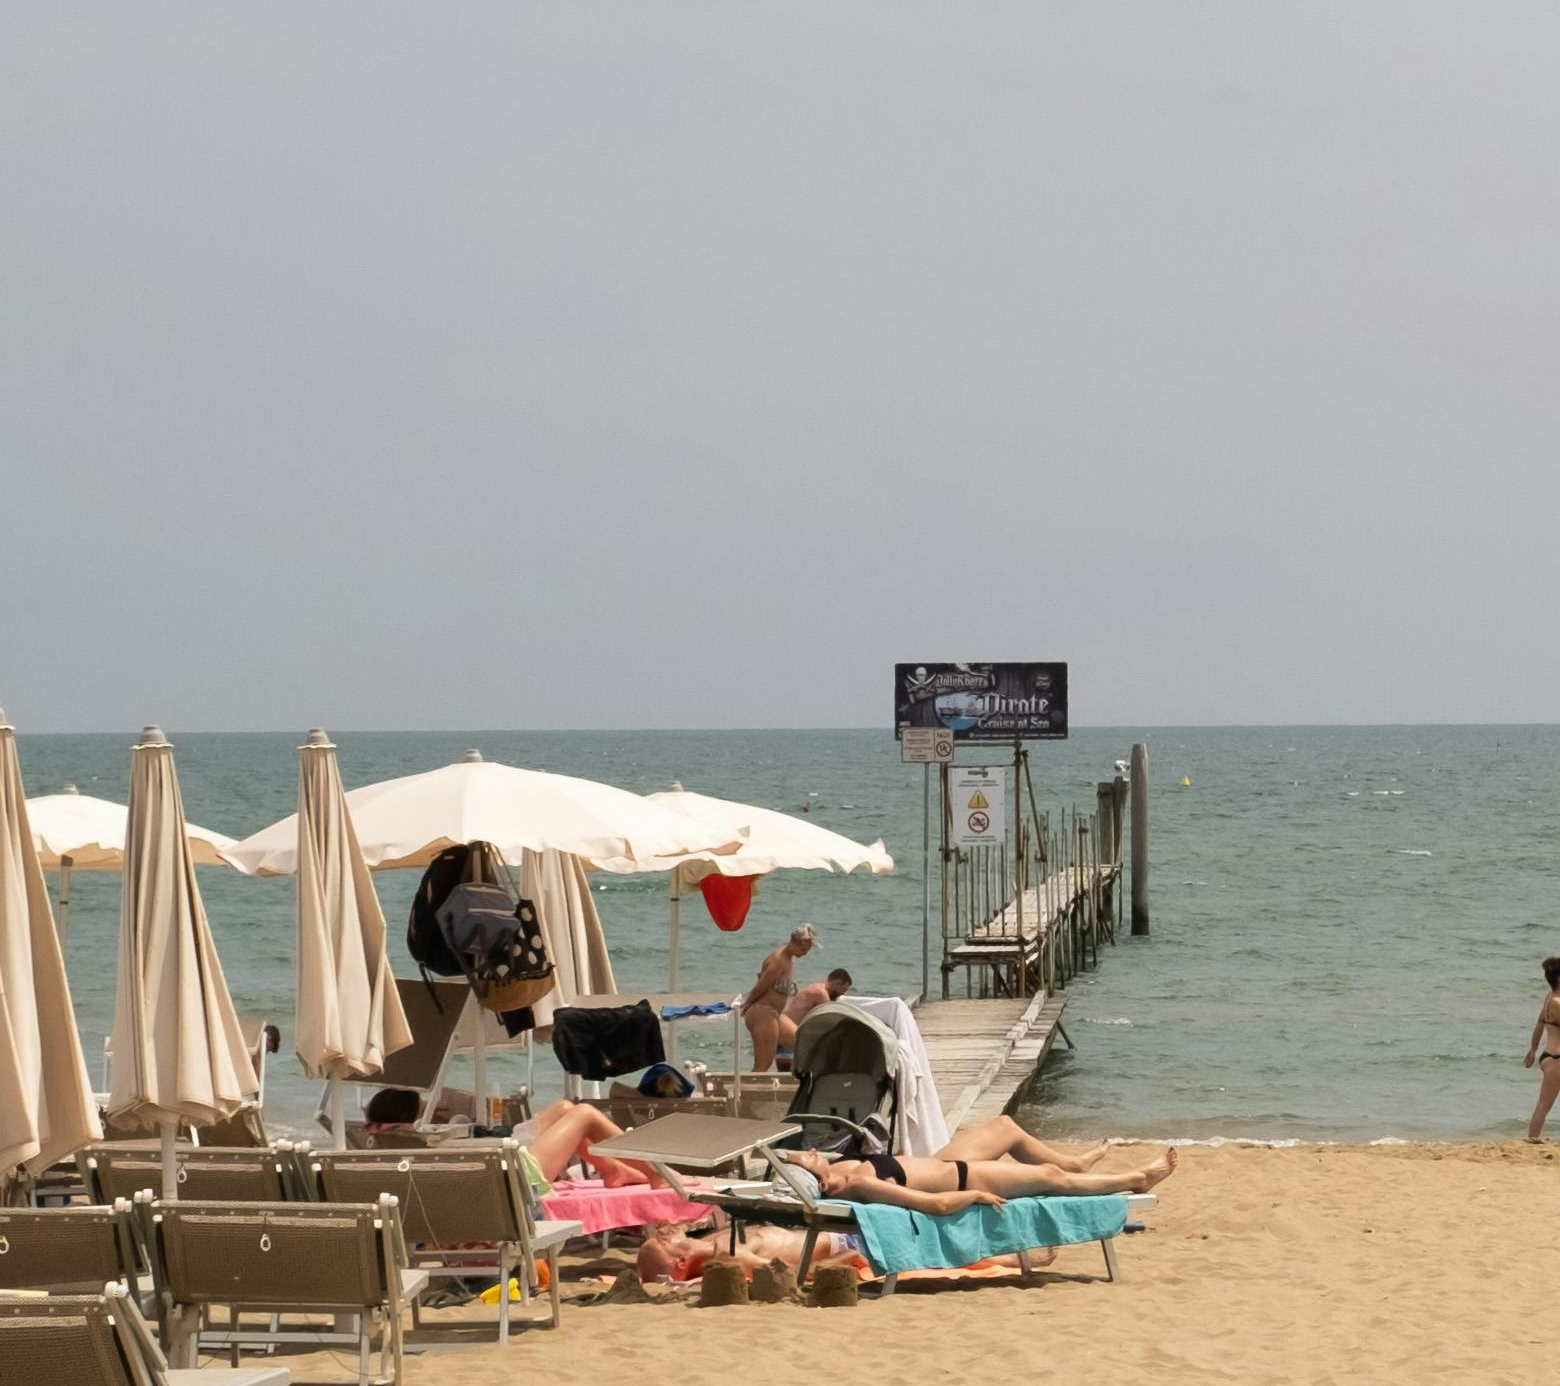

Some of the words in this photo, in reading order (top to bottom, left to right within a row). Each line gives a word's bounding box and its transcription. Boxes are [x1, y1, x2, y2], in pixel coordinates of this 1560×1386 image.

[981, 692, 1049, 715] Pirate
[978, 717, 1015, 729] Cruise
[1030, 716, 1050, 729] Sea
